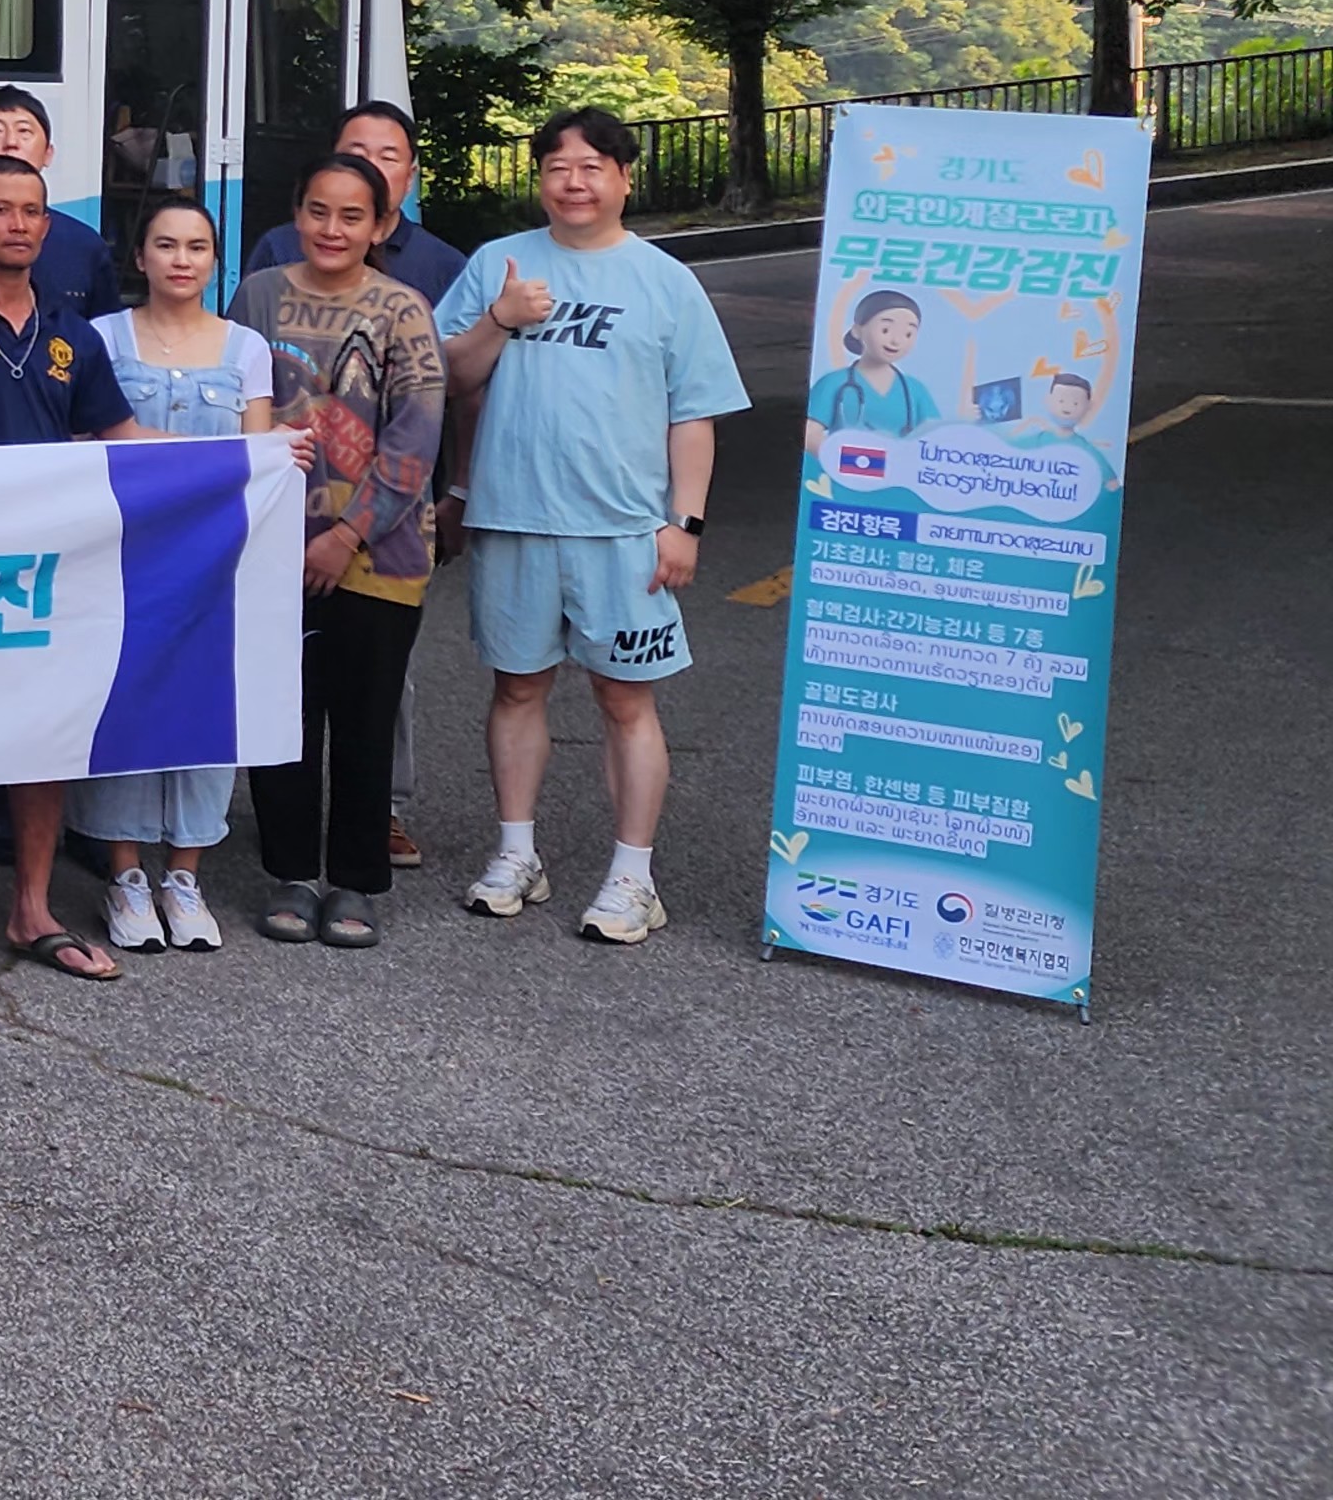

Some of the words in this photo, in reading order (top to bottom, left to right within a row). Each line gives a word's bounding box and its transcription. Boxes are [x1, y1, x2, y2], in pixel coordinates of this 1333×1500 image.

[937, 155, 1025, 184] 경기도
[827, 234, 1120, 299] 무료건강검진
[811, 539, 891, 567] 기초검사:
[896, 550, 940, 573] 혈압,
[947, 557, 983, 579] 체온
[609, 621, 678, 664] NIKE
[986, 623, 1005, 643] 등
[1013, 626, 1043, 648] 7종
[1005, 650, 1015, 666] 7
[804, 681, 898, 712] 골밀도검사
[864, 774, 921, 802] 한센병
[927, 784, 946, 806] 등
[952, 788, 1031, 820] 피부질환
[864, 883, 920, 910] 경기도
[846, 909, 910, 938] GAFI
[983, 902, 1064, 931] 질병관리청
[958, 935, 1069, 972] 한국한센복지협회
